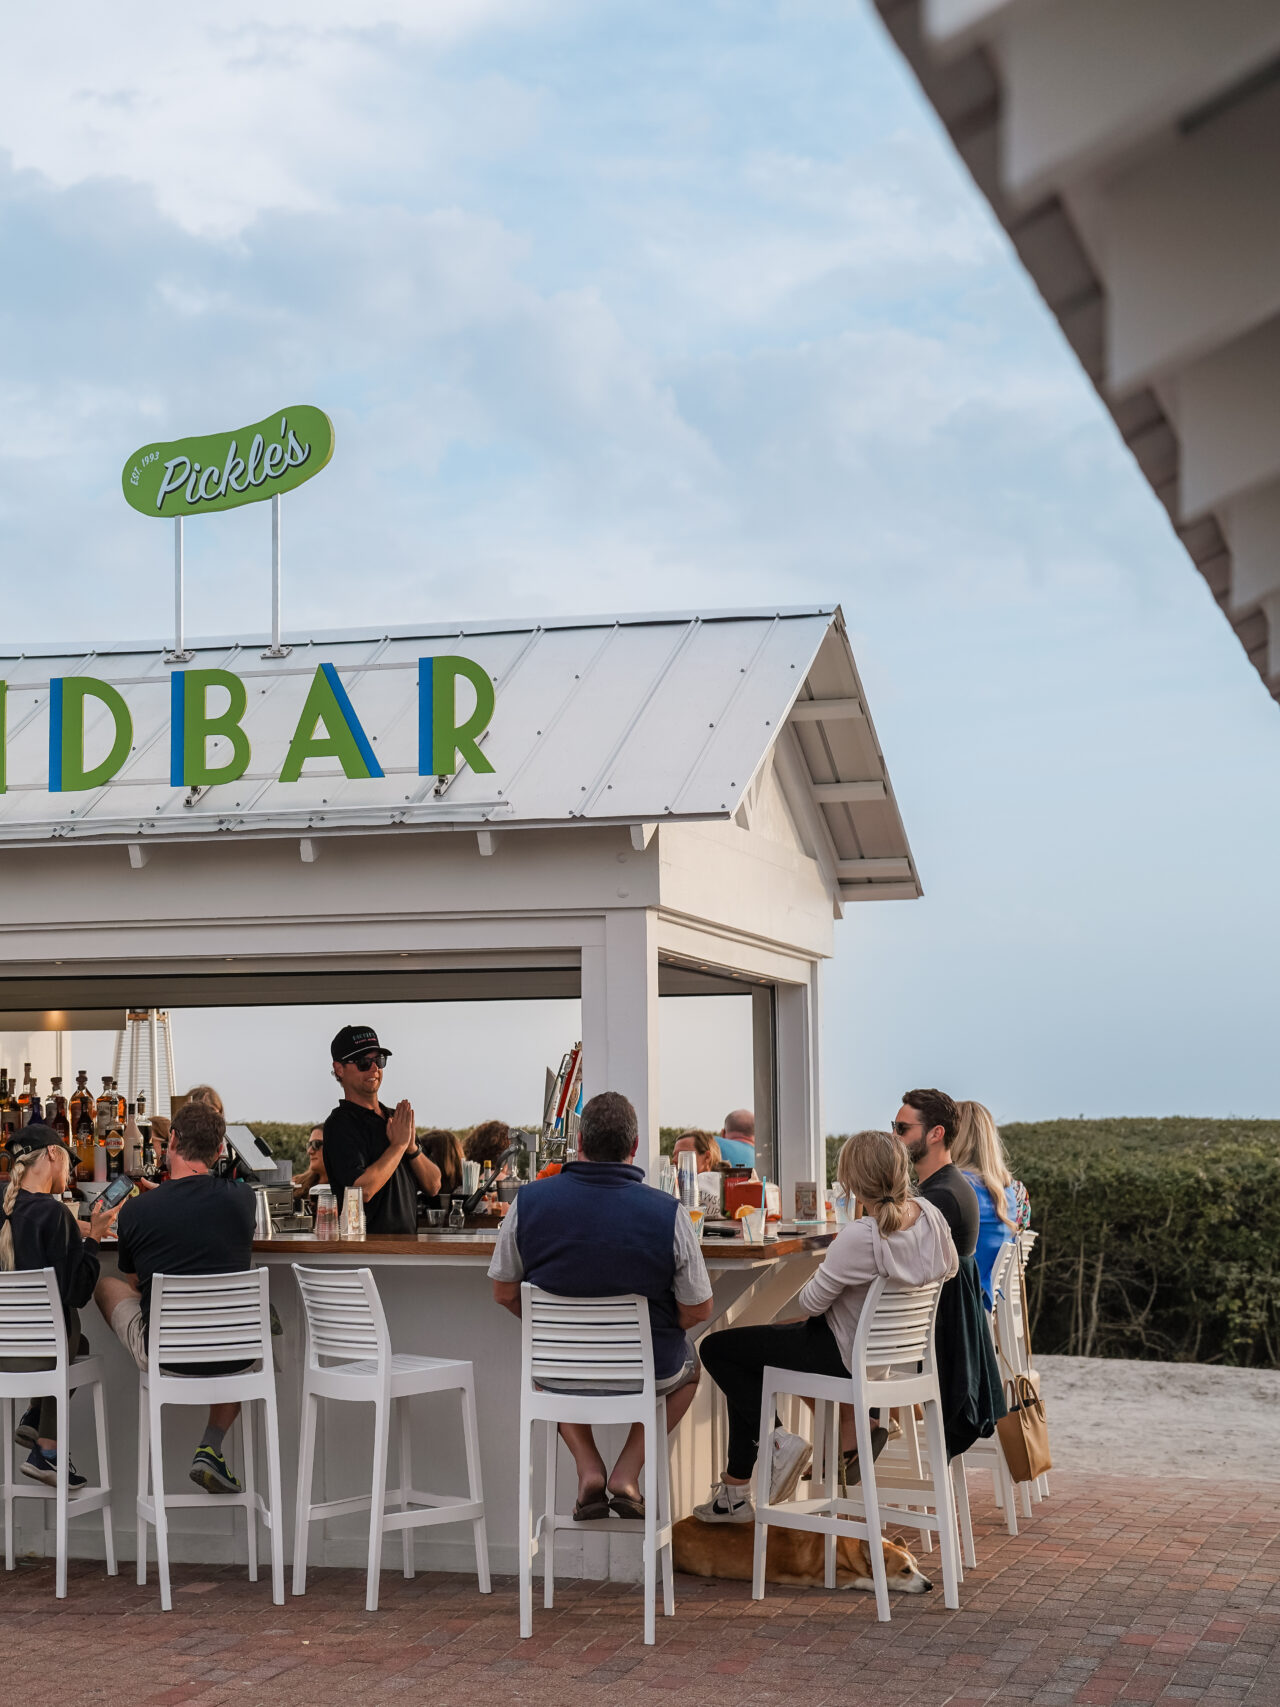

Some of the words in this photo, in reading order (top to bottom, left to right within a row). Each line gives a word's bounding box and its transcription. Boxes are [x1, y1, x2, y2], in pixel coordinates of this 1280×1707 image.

[130, 467, 143, 486] EST.
[141, 451, 160, 467] 1993
[156, 416, 311, 510] Pickle's
